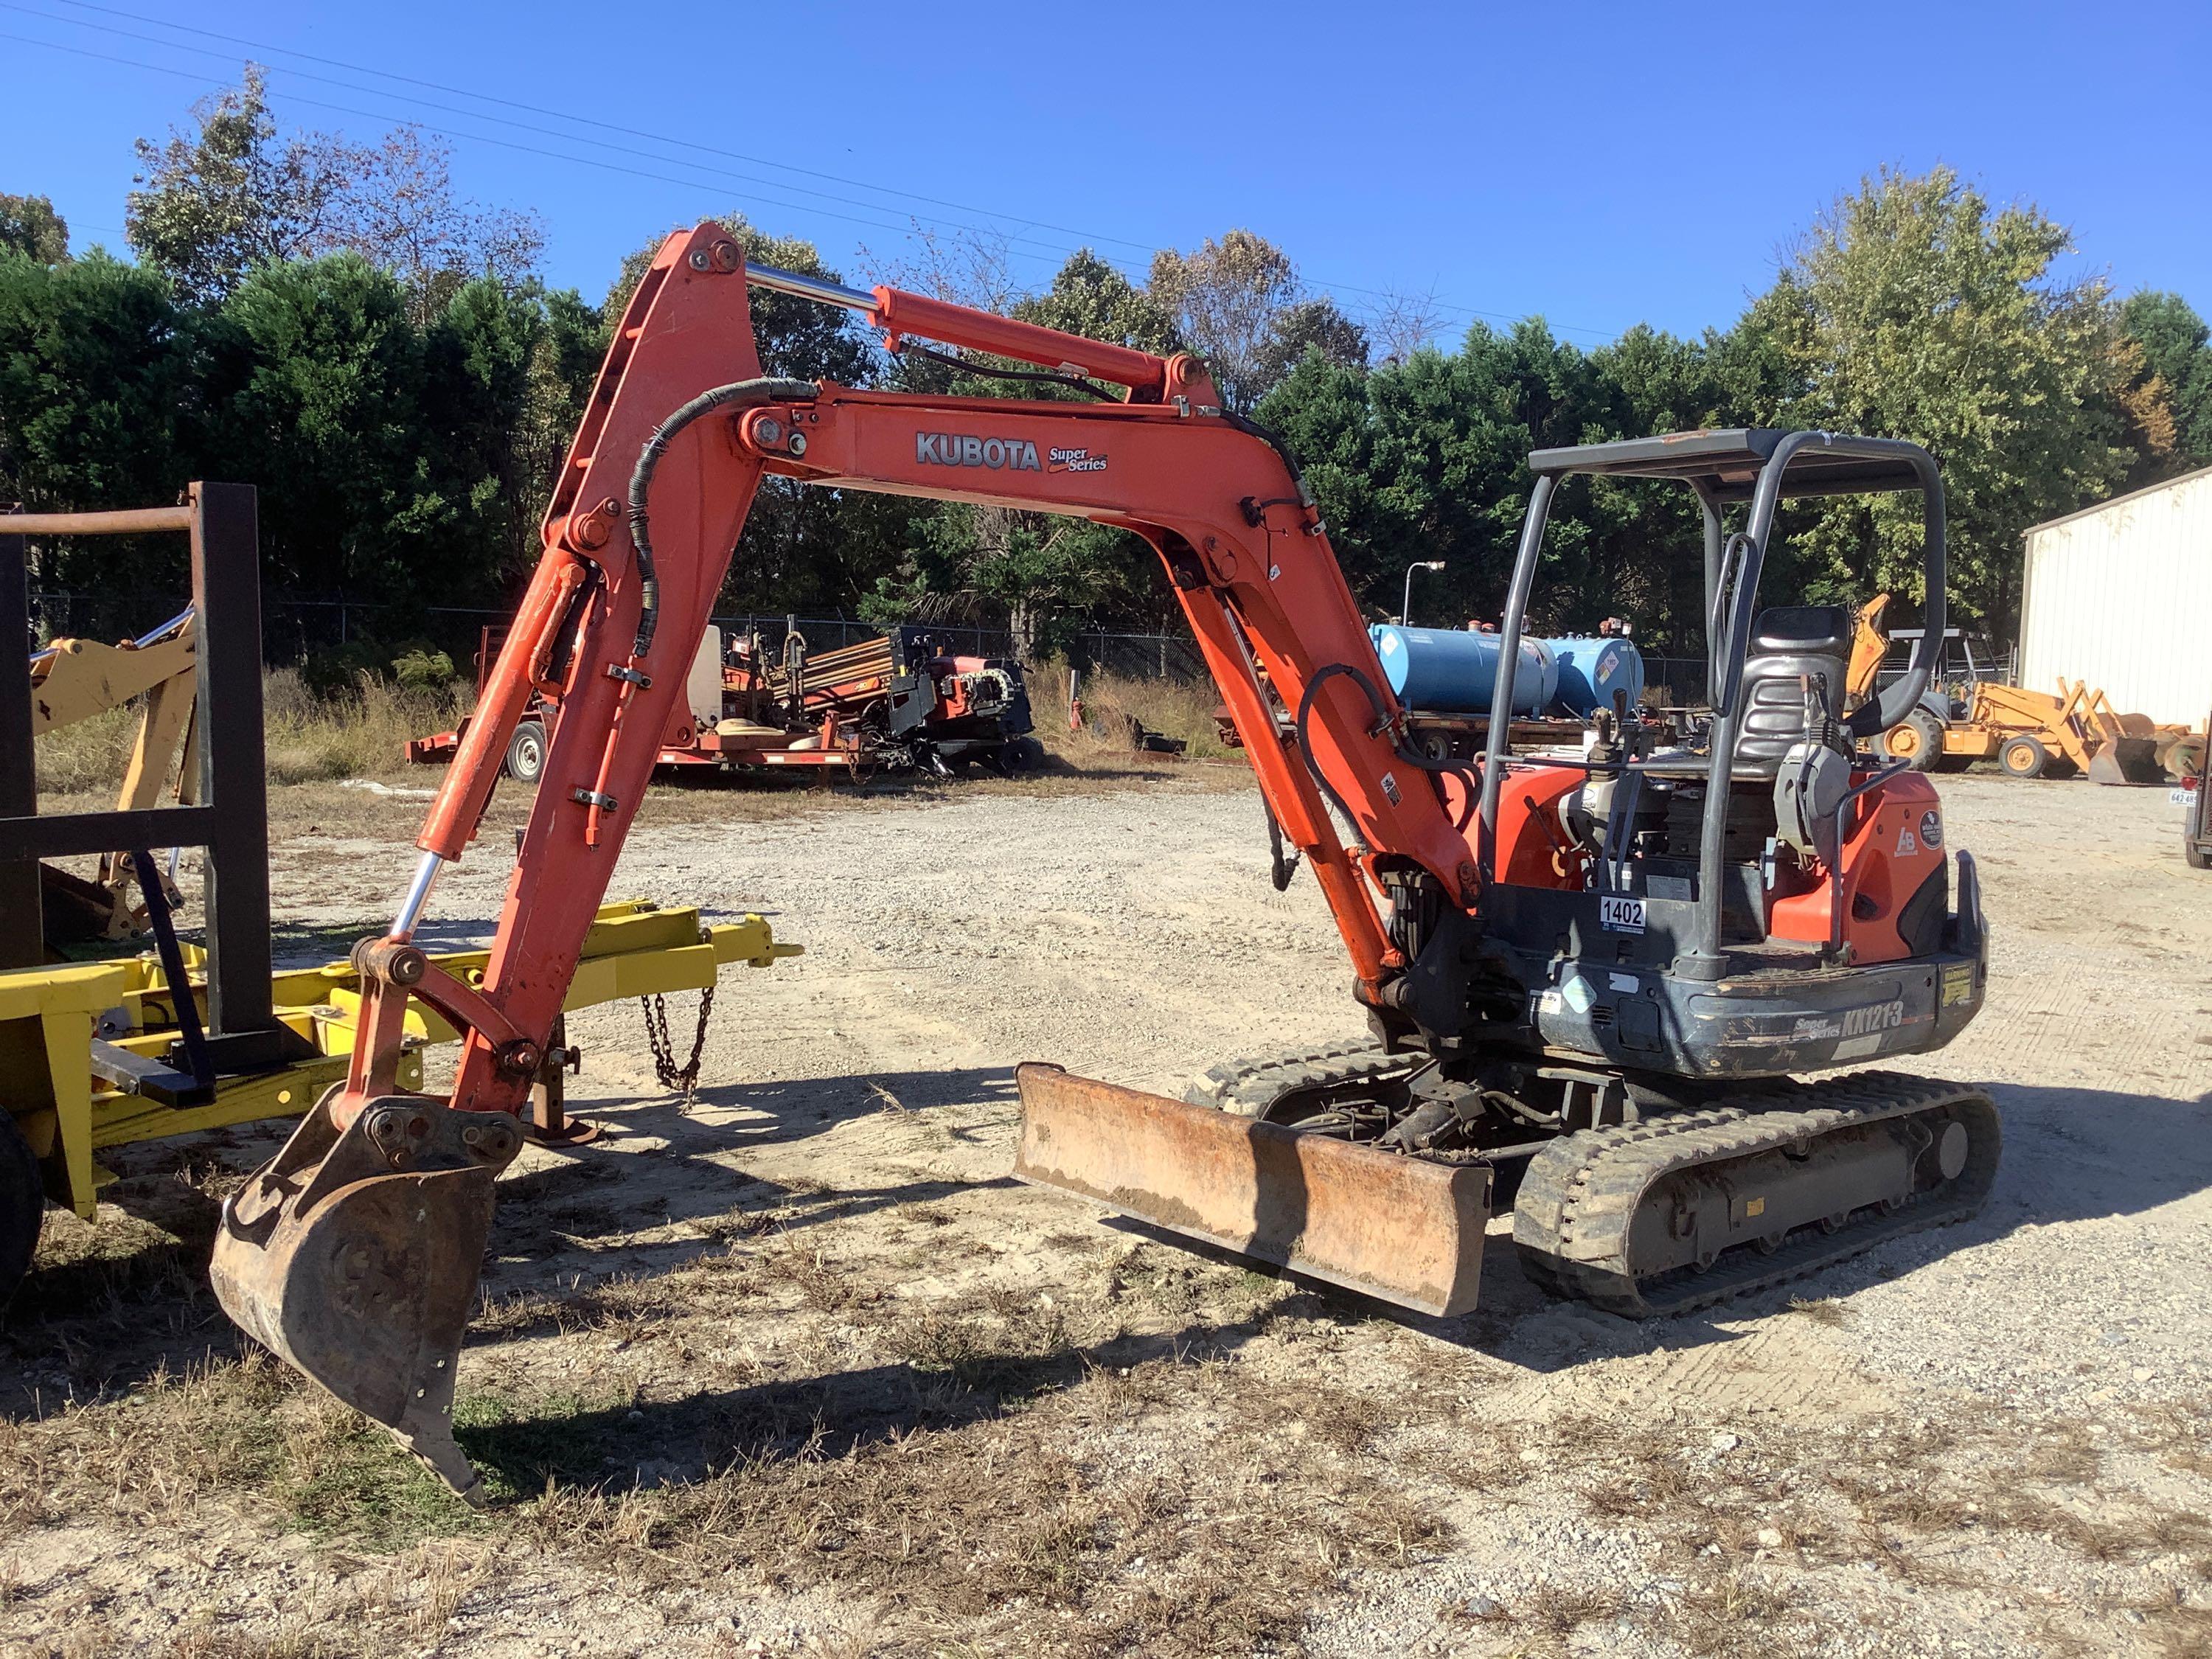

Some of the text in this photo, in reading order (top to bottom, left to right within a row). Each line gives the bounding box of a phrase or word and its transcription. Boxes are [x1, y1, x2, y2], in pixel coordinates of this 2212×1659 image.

[917, 433, 1041, 472] KUBOTA
[1048, 447, 1087, 462] Super
[1068, 458, 1107, 473] Series
[2171, 793, 2184, 802] 642
[1604, 900, 1642, 925] 1402
[1794, 1018, 1829, 1032] Super
[1842, 1001, 1904, 1037] KX121-3
[1809, 1024, 1841, 1040] Series
